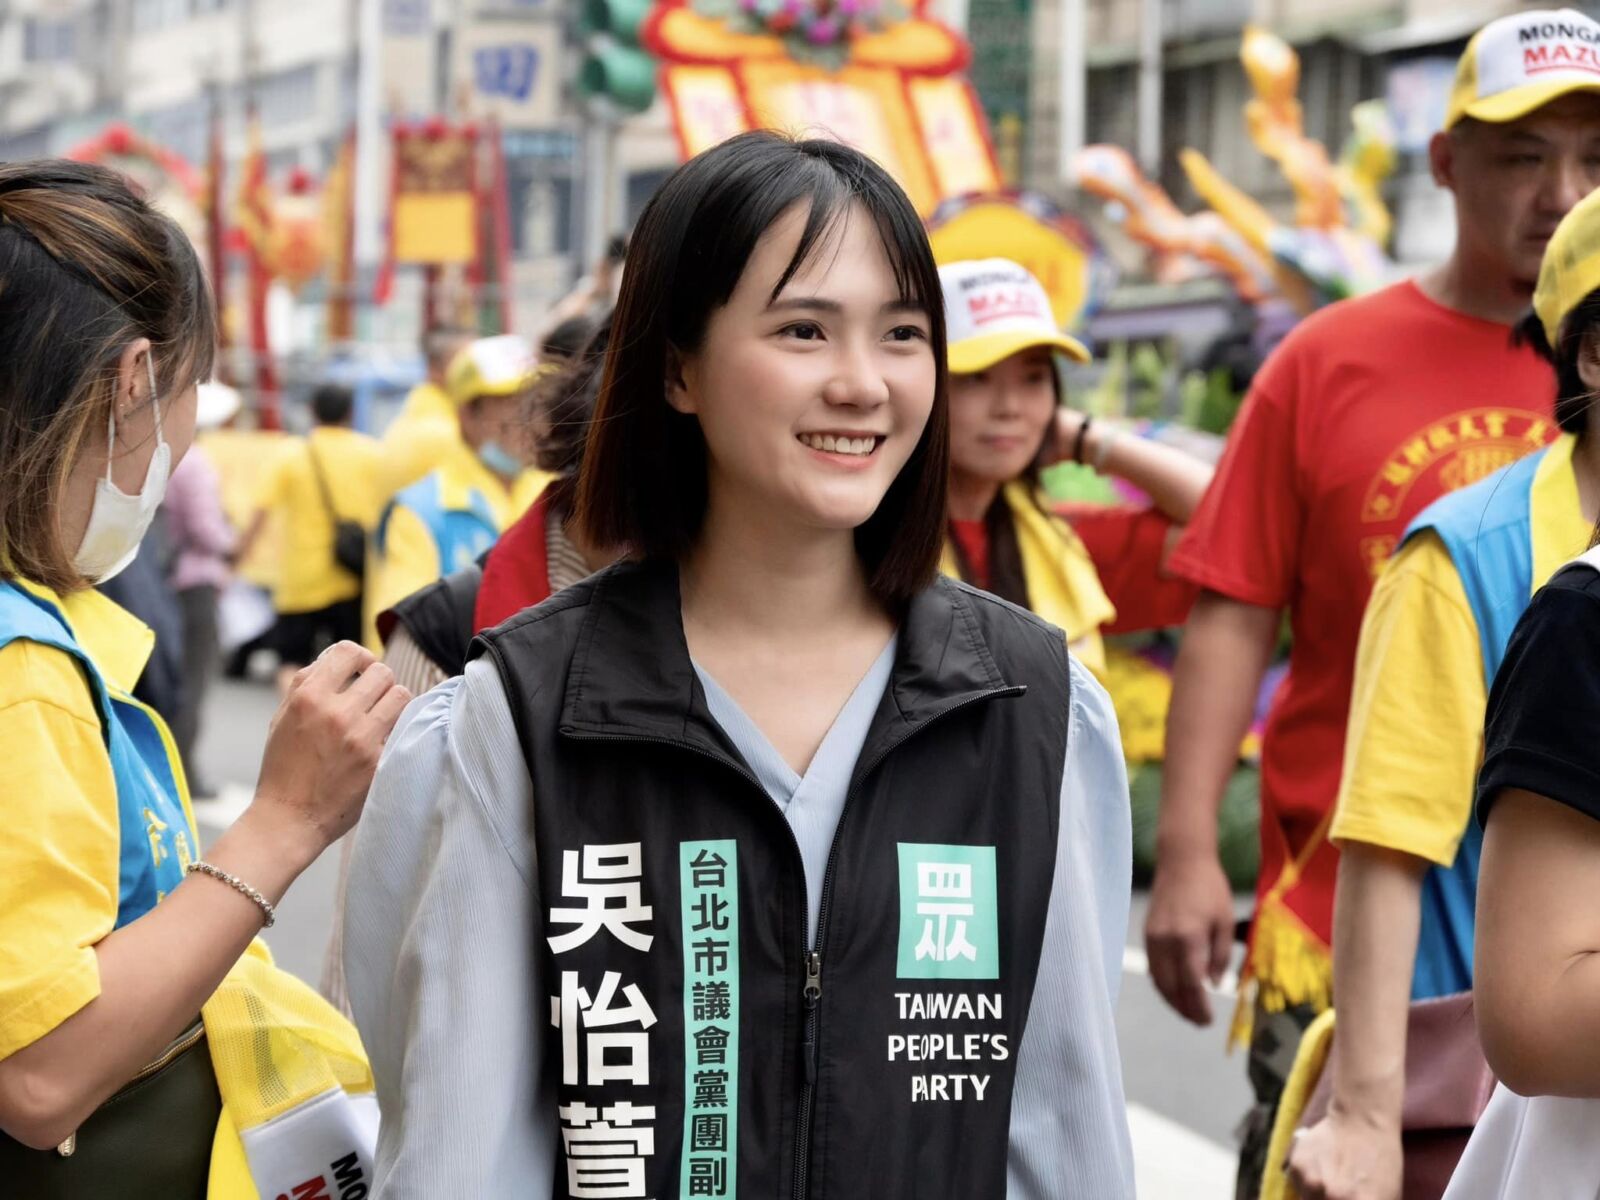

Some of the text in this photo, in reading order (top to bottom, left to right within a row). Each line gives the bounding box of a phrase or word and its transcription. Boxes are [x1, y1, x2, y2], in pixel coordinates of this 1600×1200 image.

[894, 993, 1002, 1020] TAIWAN
[547, 842, 658, 1200] 吳怡萱
[689, 849, 731, 1197] 台北市議會黨團副
[888, 1034, 1009, 1061] PEOPLE'S
[912, 1074, 991, 1102] PARTY
